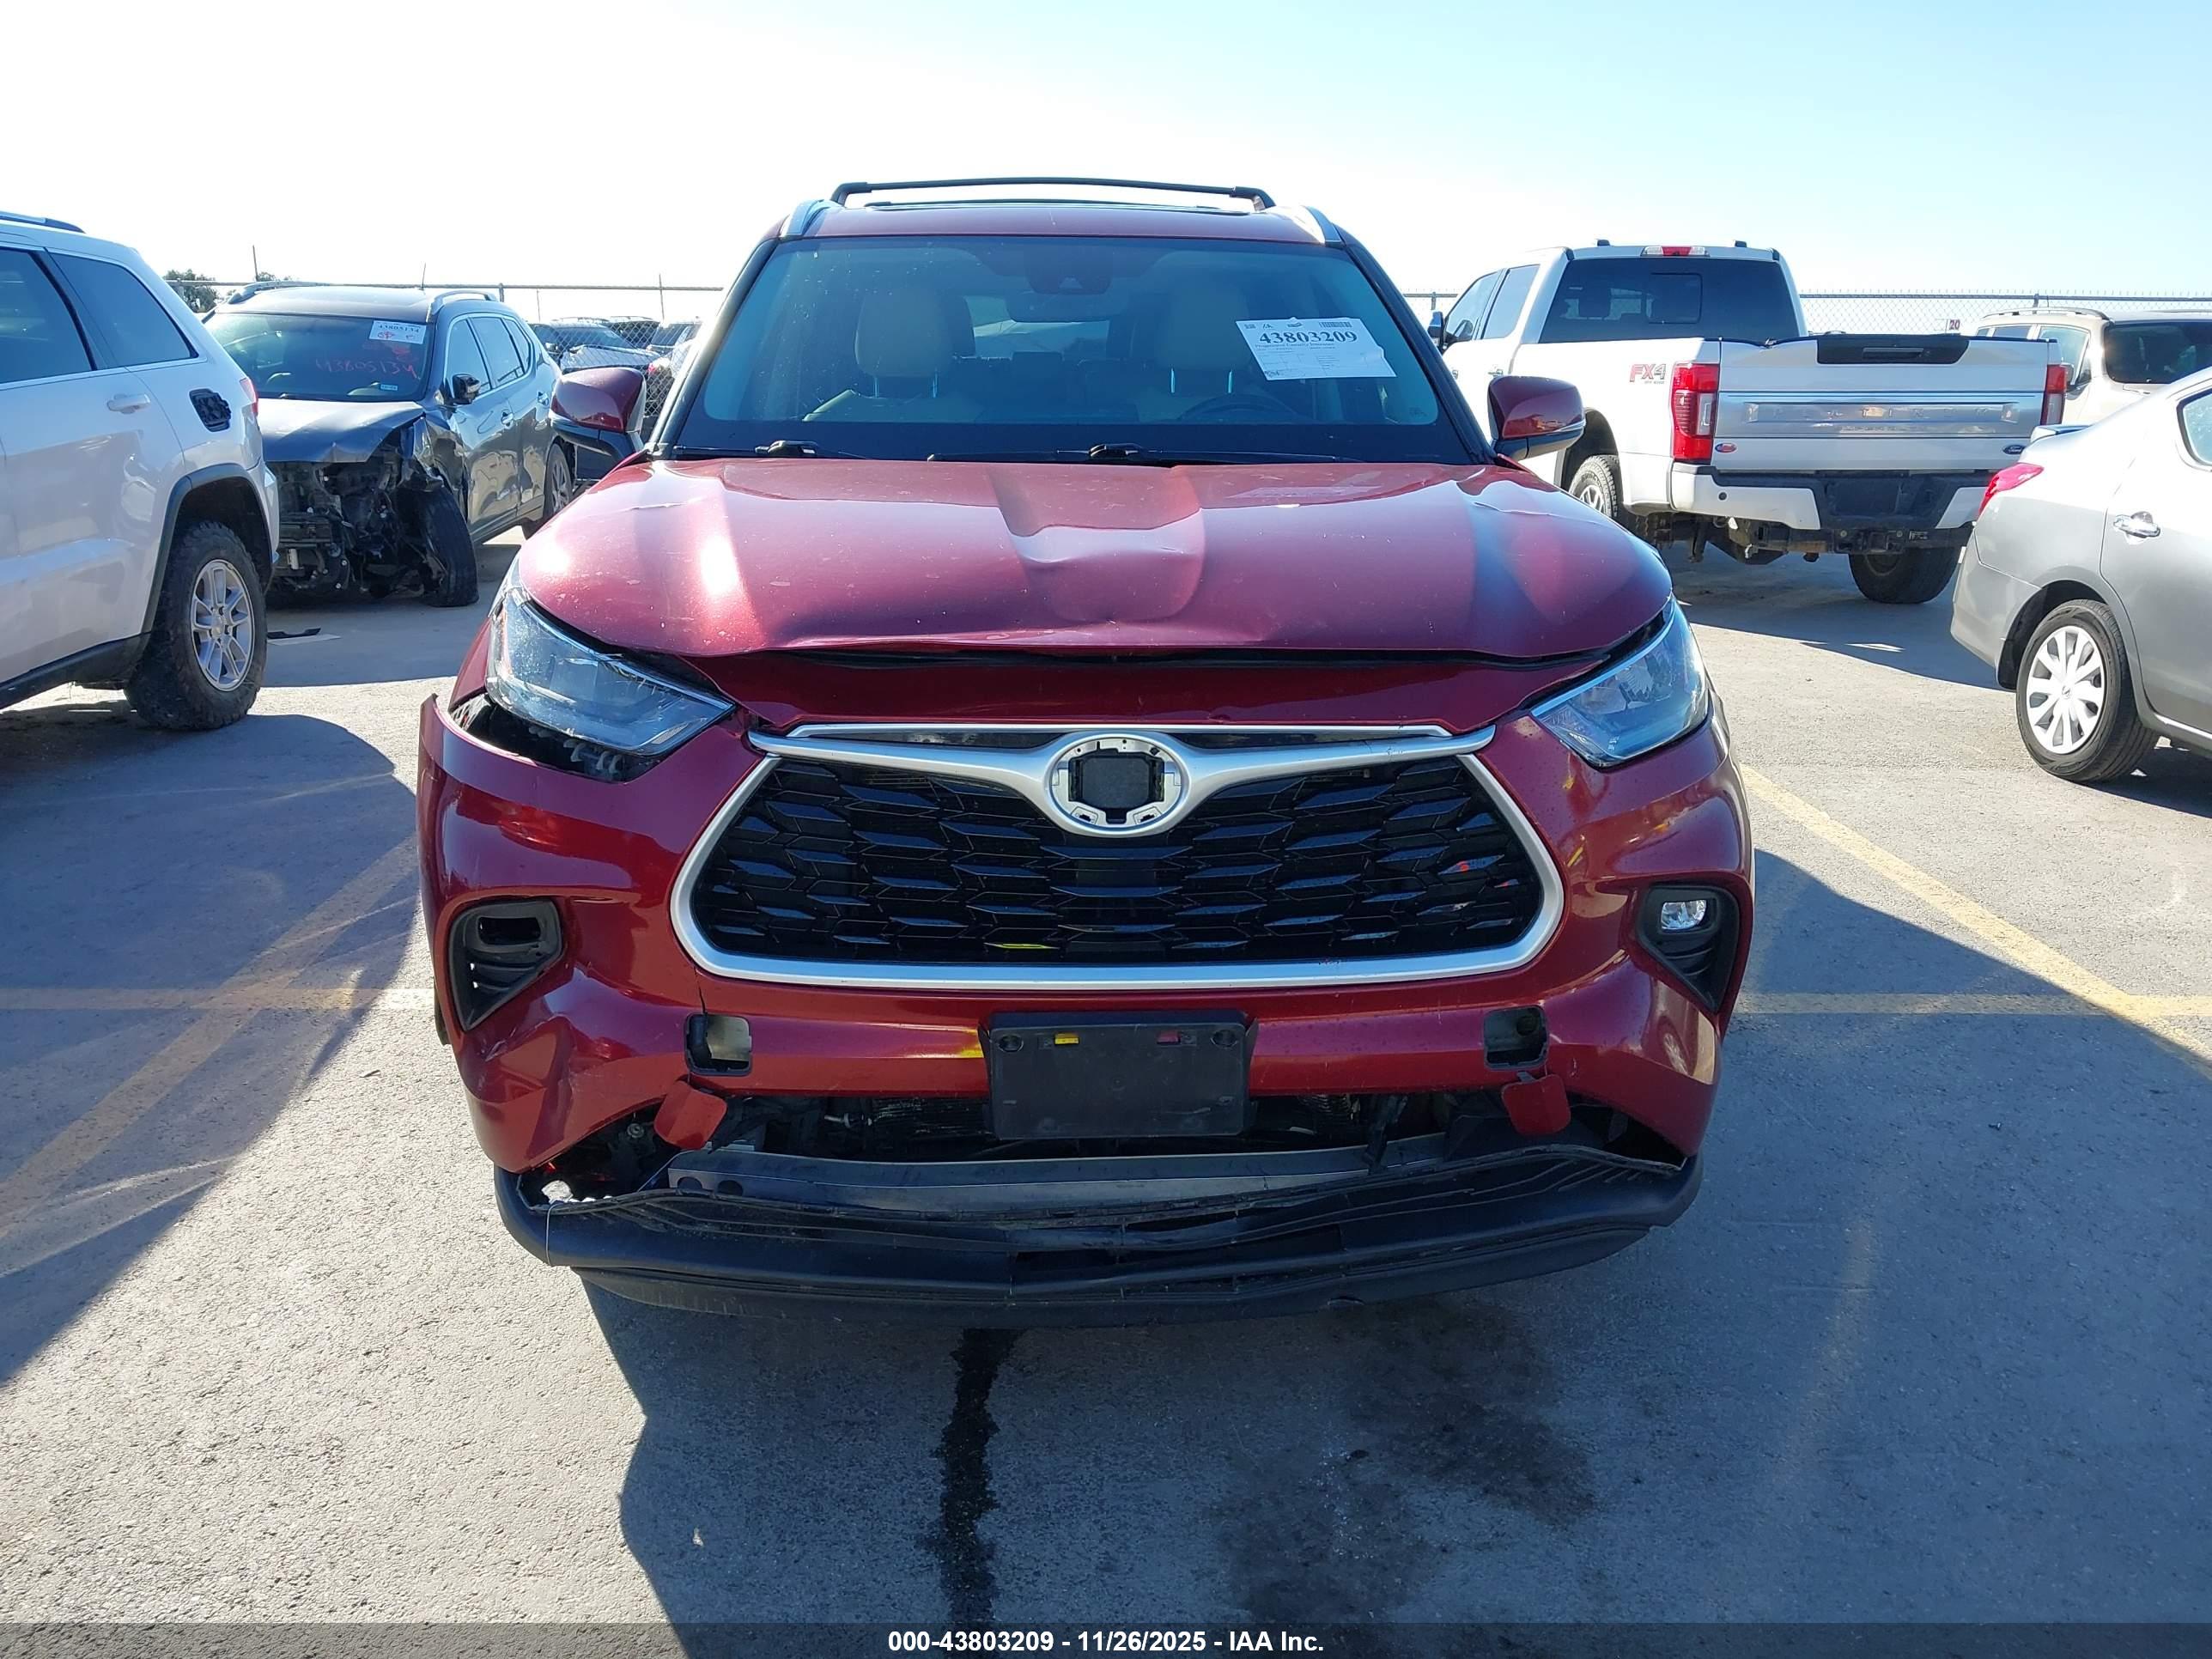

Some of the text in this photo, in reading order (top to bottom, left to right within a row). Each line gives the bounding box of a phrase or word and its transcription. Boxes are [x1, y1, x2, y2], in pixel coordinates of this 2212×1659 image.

[1949, 319, 1960, 331] 20
[1259, 331, 1358, 343] 43803209
[1629, 363, 1667, 383] FX4
